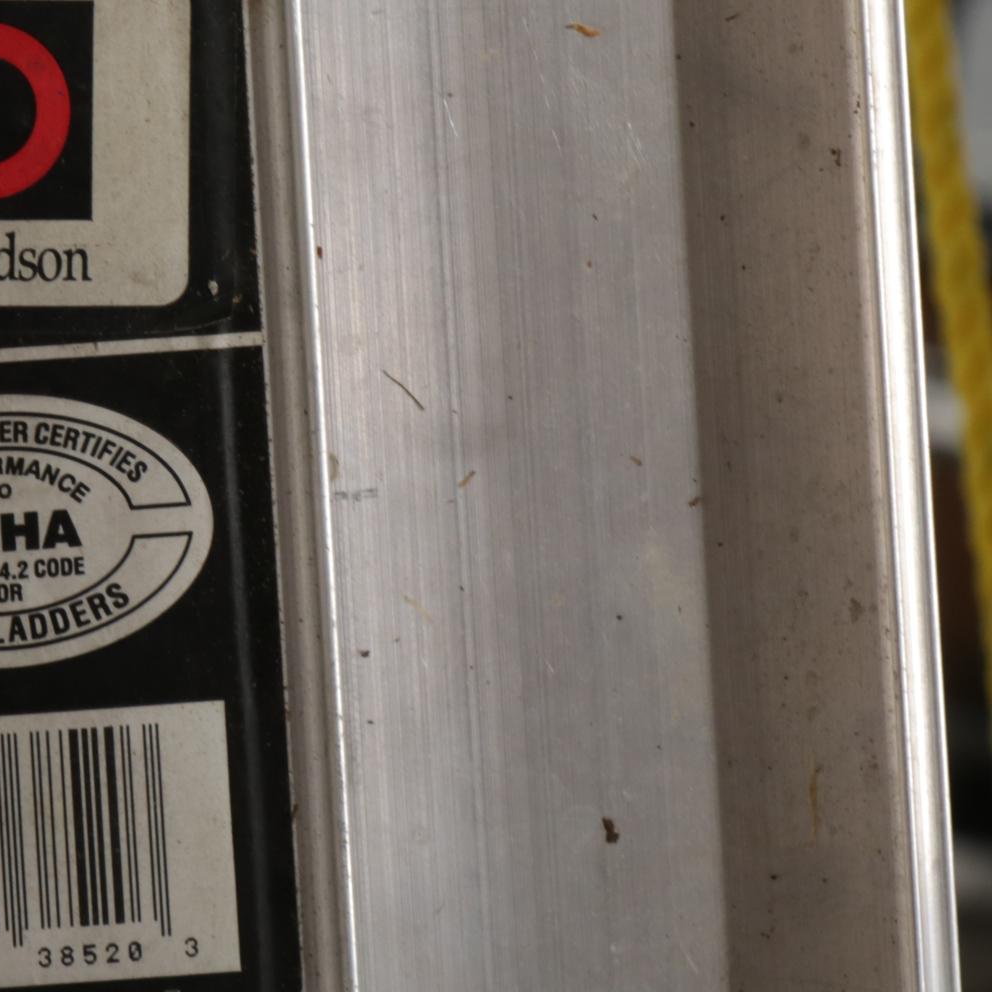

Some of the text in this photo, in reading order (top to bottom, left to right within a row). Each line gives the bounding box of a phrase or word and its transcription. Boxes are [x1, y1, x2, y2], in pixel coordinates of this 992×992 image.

[35, 423, 148, 484] CERTIFIES
[35, 557, 85, 577] CODE
[38, 942, 142, 968] 38520
[185, 938, 199, 958] 3
